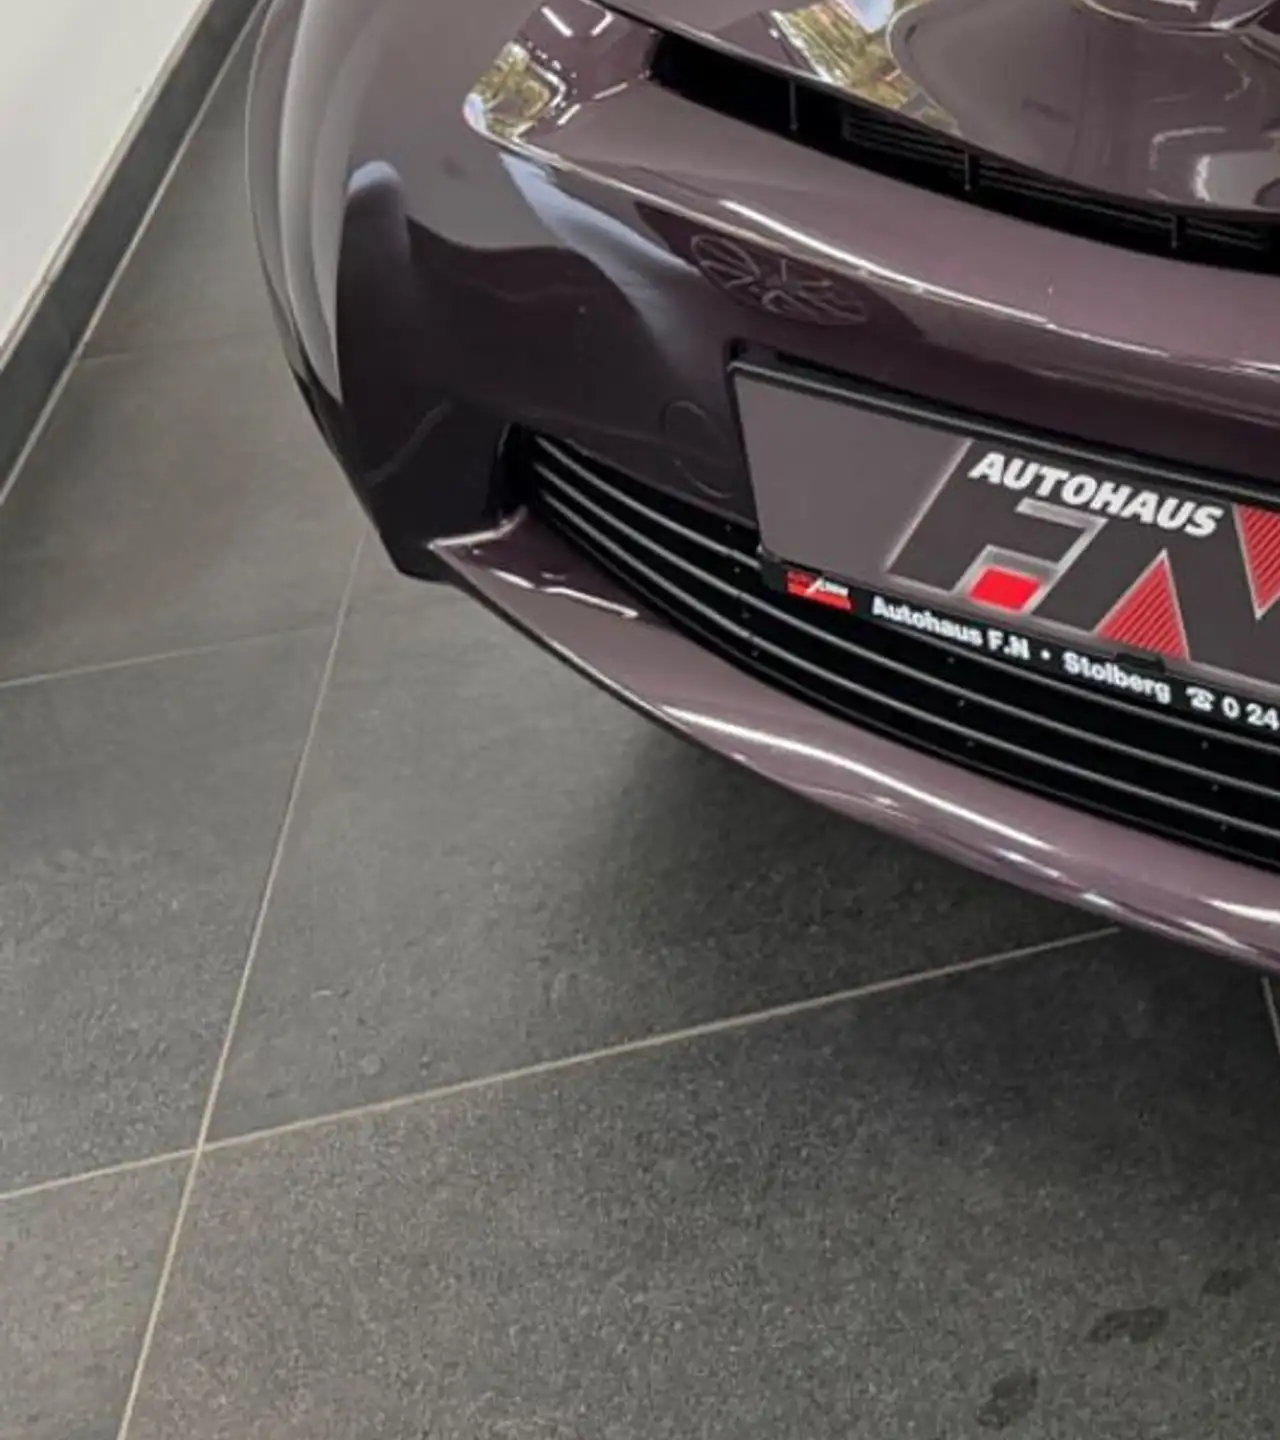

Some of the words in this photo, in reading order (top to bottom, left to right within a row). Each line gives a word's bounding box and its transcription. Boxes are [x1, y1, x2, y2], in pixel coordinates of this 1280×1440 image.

[968, 451, 1225, 539] AUTOHAUS
[871, 594, 983, 647] Autohaus
[986, 627, 1032, 661] F.N
[1061, 650, 1172, 705] Stolberg
[1221, 696, 1240, 720] 0
[1245, 703, 1280, 731] 24
